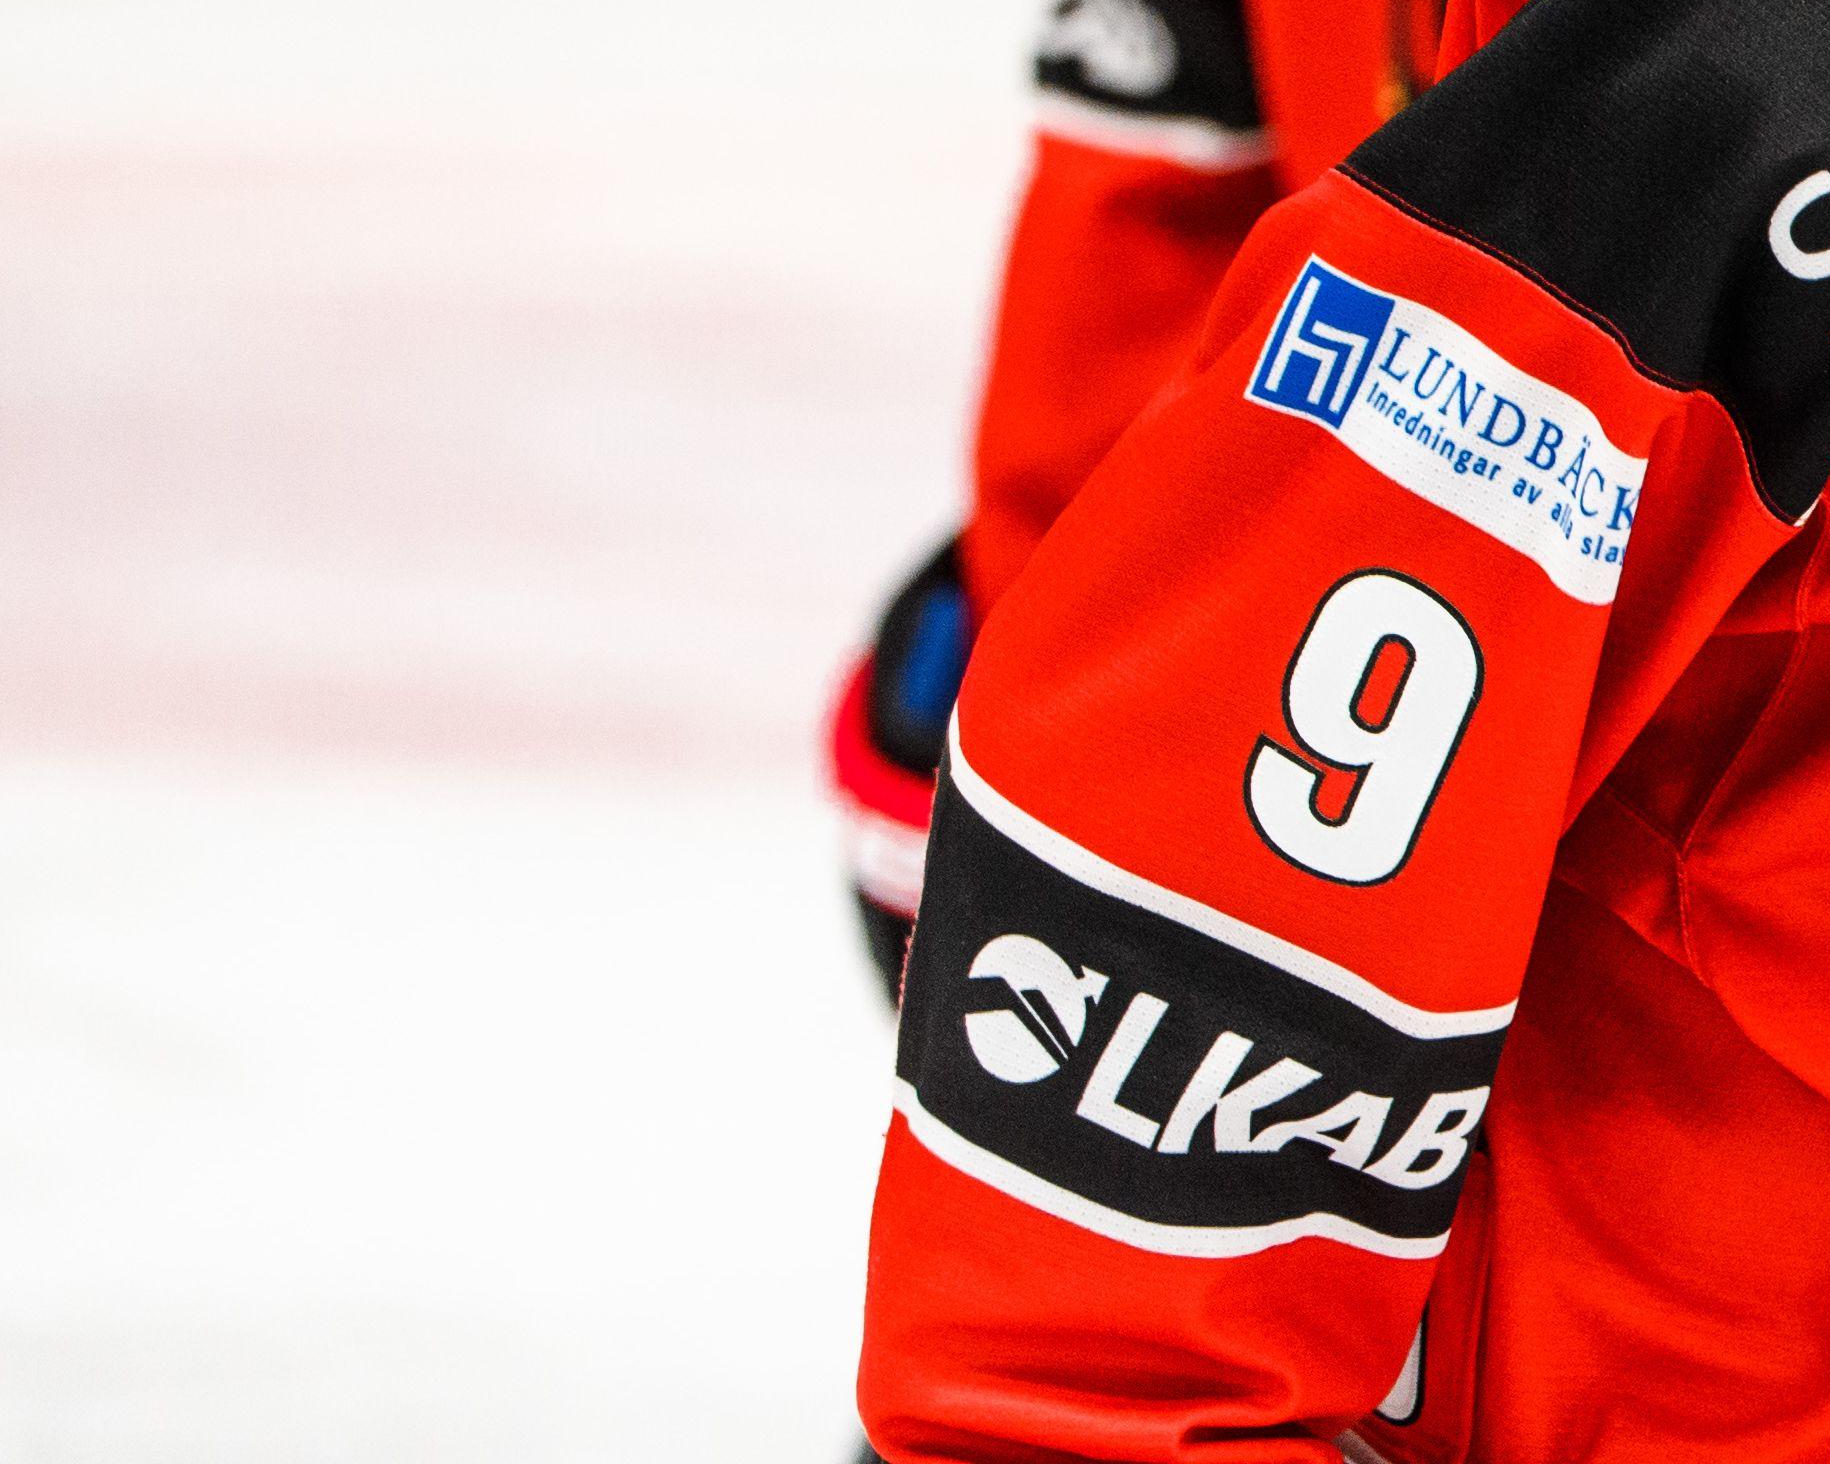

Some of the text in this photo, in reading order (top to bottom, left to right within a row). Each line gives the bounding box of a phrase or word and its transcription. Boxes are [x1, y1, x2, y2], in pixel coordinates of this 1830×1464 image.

[1365, 381, 1503, 482] Inredningar
[1511, 477, 1544, 505] av
[1550, 502, 1574, 541] alla
[1243, 567, 1485, 887] 9
[1076, 992, 1490, 1191] LKAB
